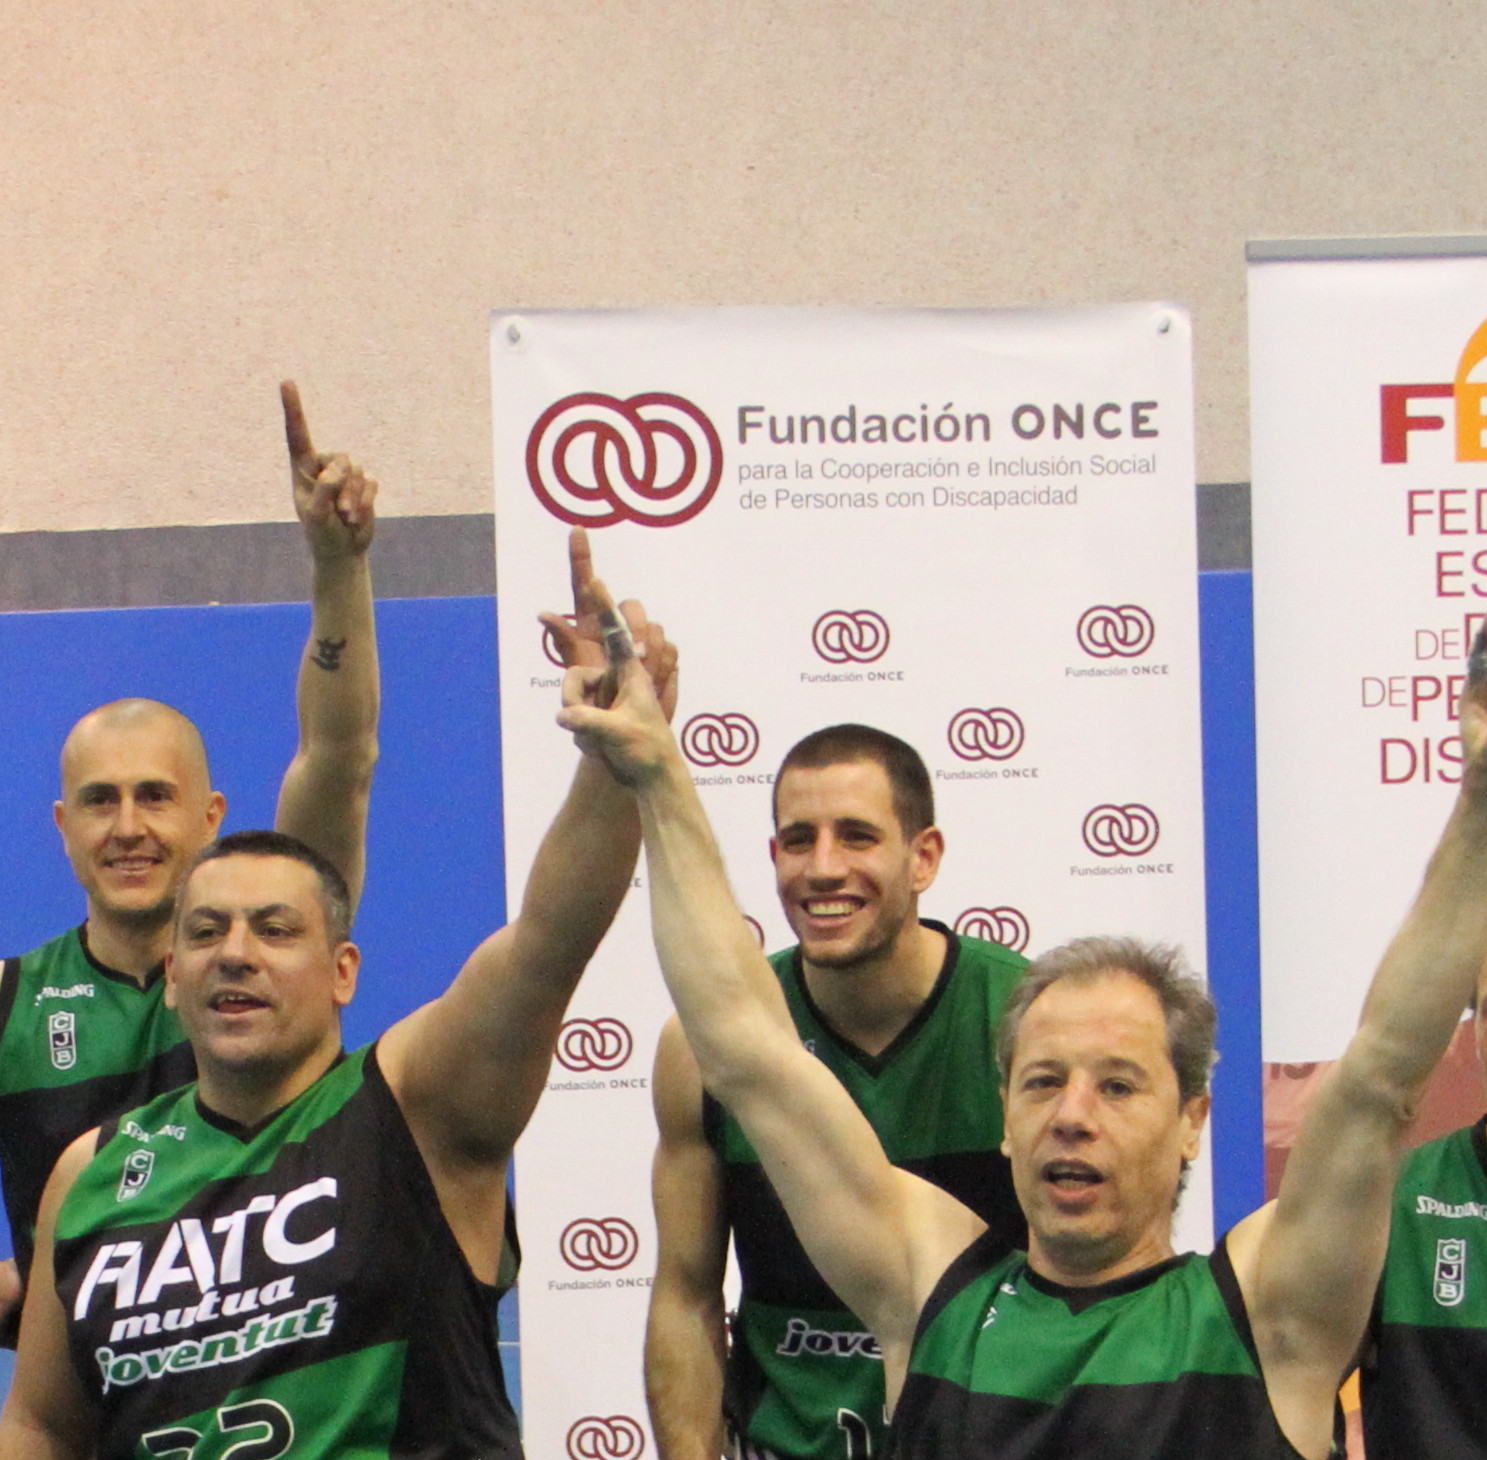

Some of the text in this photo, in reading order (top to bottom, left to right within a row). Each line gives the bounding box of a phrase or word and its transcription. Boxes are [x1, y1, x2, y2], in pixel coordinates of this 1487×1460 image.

[737, 400, 1160, 445] Fundación ONCE
[737, 453, 1157, 485] para la Cooperación e Inclusión Social
[739, 485, 1078, 511] de Personas con Discapacidad
[1415, 628, 1461, 661] DE
[800, 670, 905, 684] Fundación ONCE
[1065, 664, 1170, 678] Fundación ONCE
[1361, 675, 1408, 708] DE
[693, 773, 775, 786] dación ONCE
[935, 767, 1040, 780] Fundación ONCE
[1070, 863, 1174, 877] Fundación ONCE
[547, 1078, 648, 1091] undación ONCE
[548, 1276, 654, 1291] Fundación ONCE
[109, 1276, 296, 1342] mutua
[95, 1295, 339, 1396] joventut
